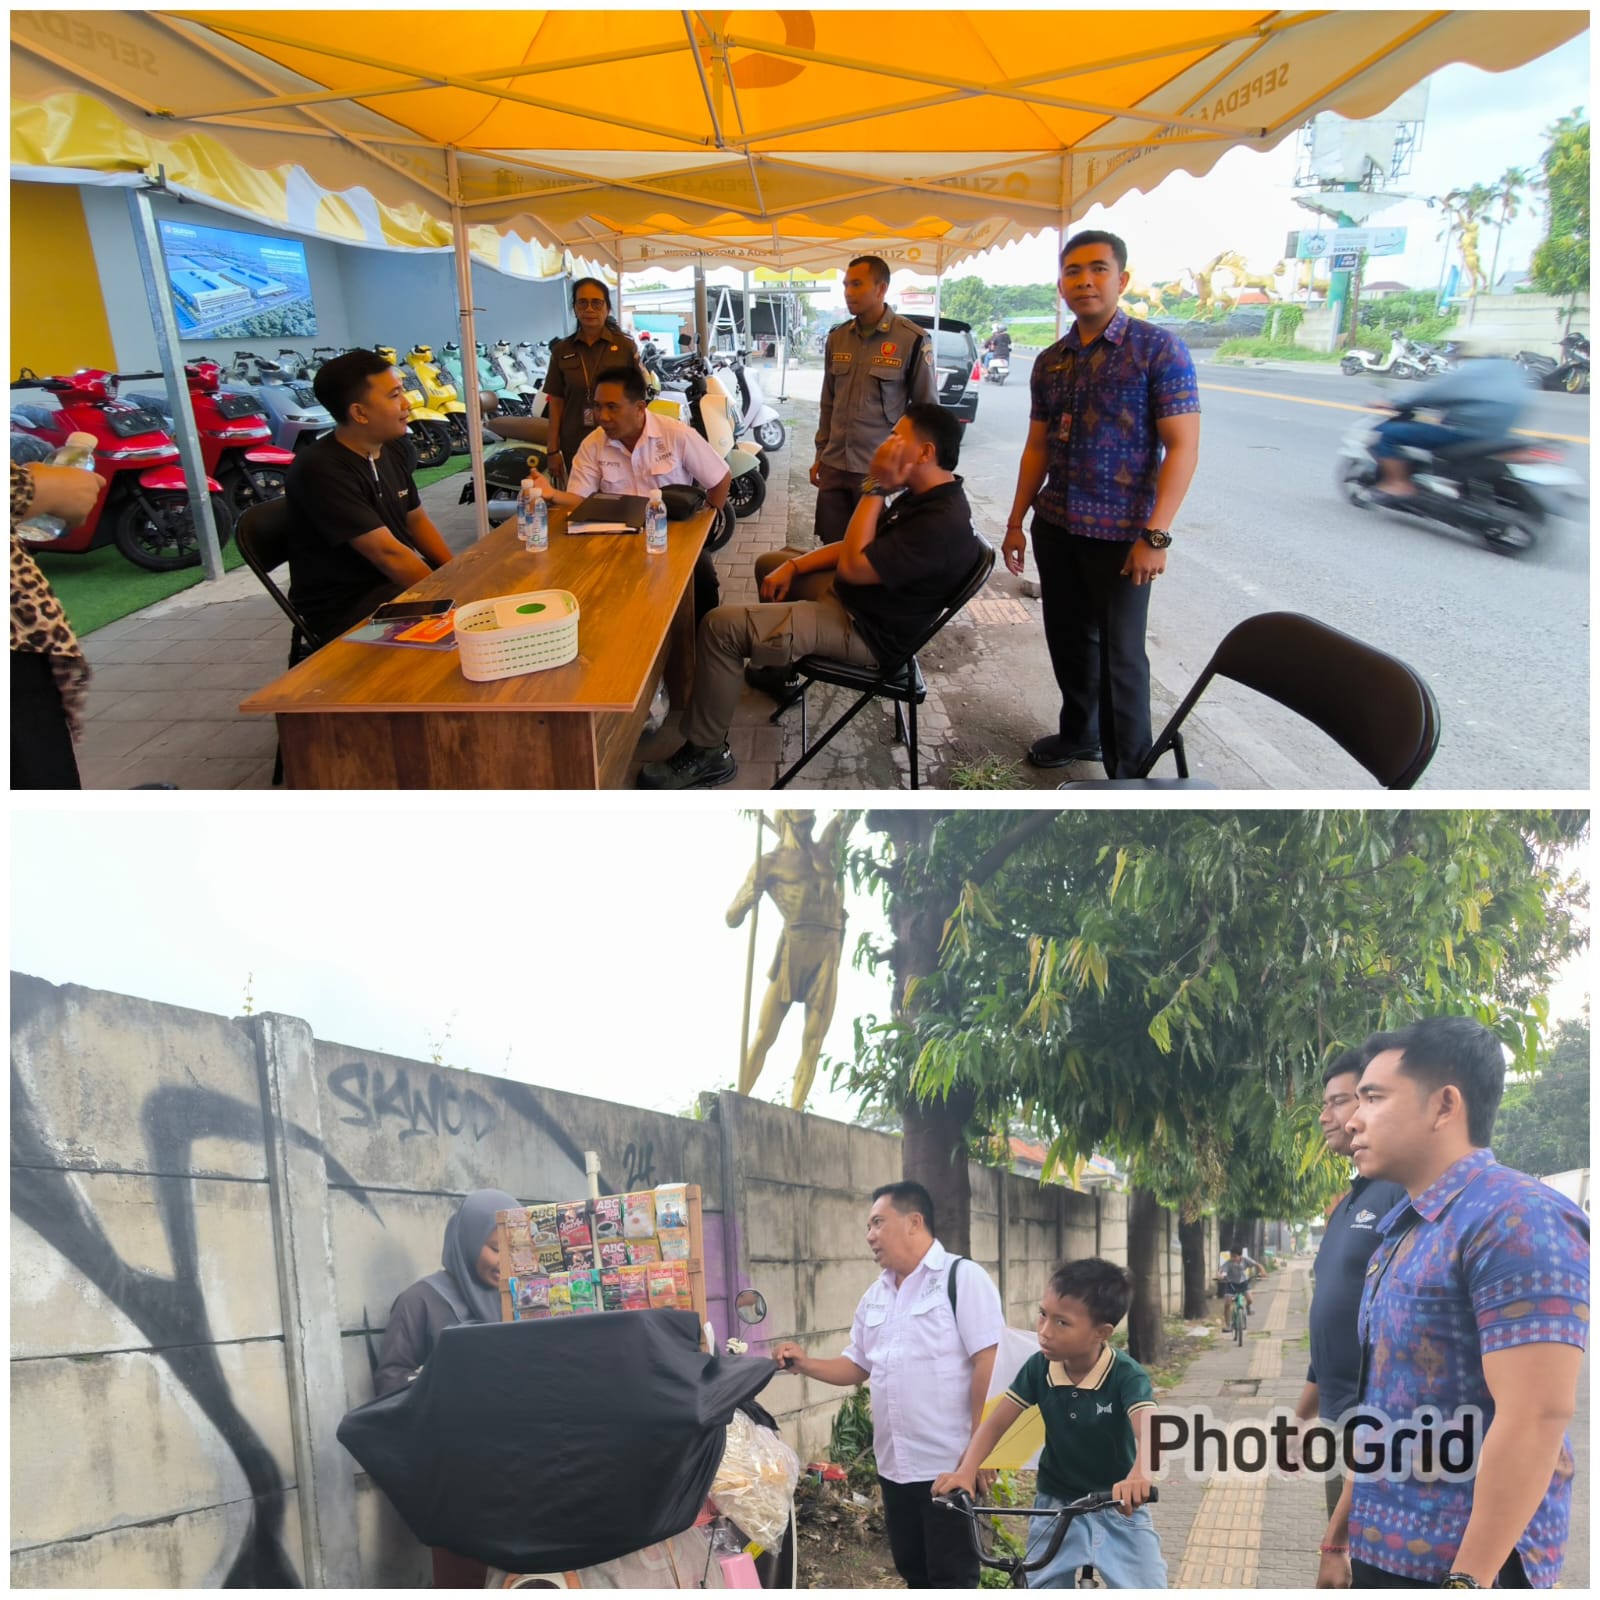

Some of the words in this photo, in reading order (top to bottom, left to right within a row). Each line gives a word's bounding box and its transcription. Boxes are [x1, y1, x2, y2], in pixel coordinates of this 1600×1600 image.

[596, 1198, 619, 1210] ABC
[531, 1206, 555, 1219] ABC
[602, 1242, 626, 1254] ABC
[538, 1251, 560, 1263] ABC
